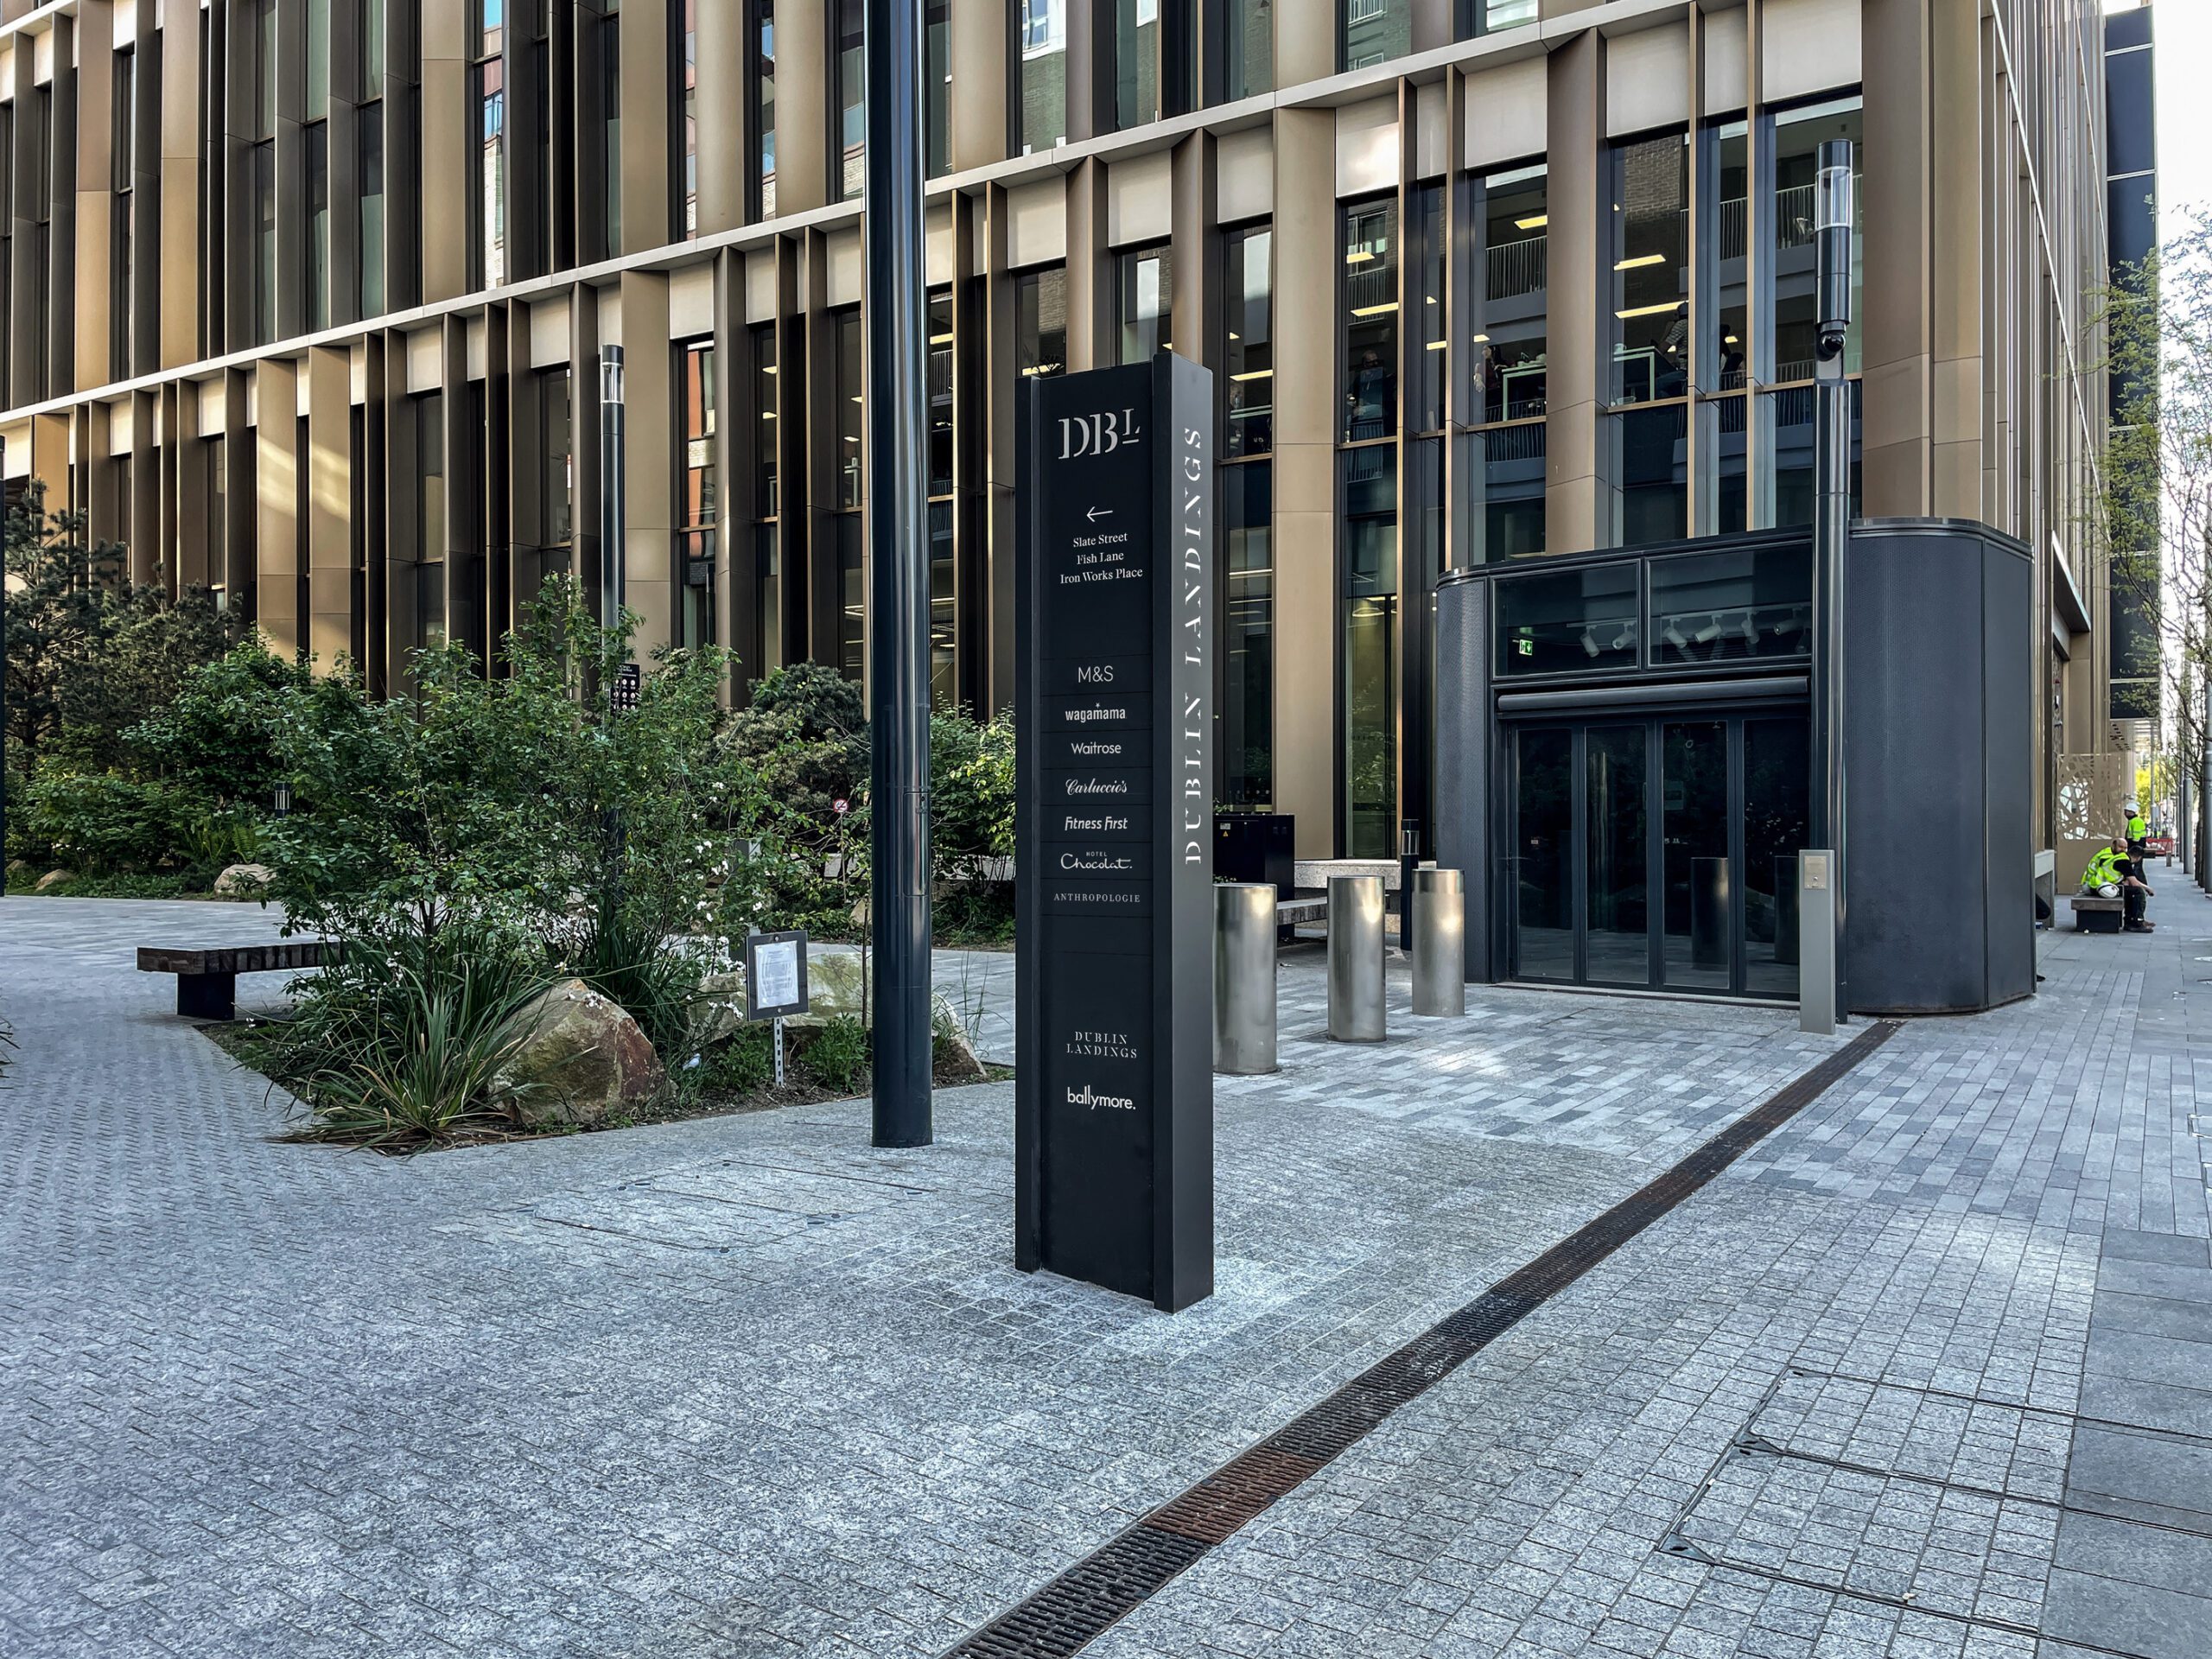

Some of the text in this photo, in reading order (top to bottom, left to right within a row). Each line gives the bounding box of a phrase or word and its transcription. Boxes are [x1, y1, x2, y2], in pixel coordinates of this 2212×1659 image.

[1073, 532, 1128, 548] Slate Street
[1077, 552, 1124, 565] Fish Lane
[1060, 568, 1143, 584] Iron Works Place
[1185, 428, 1201, 865] DUBLIN LANDINGS
[1077, 665, 1114, 683] M&S
[1065, 707, 1126, 723] wagamama
[1071, 741, 1122, 755] Waitrose
[1065, 778, 1128, 796] Carluccio's
[1053, 893, 1141, 903] ANTHROPOLOGIE
[1075, 1031, 1128, 1045] DUBLIN
[1066, 1043, 1137, 1058] LANDINGS
[1067, 1085, 1136, 1110] ballymore.
